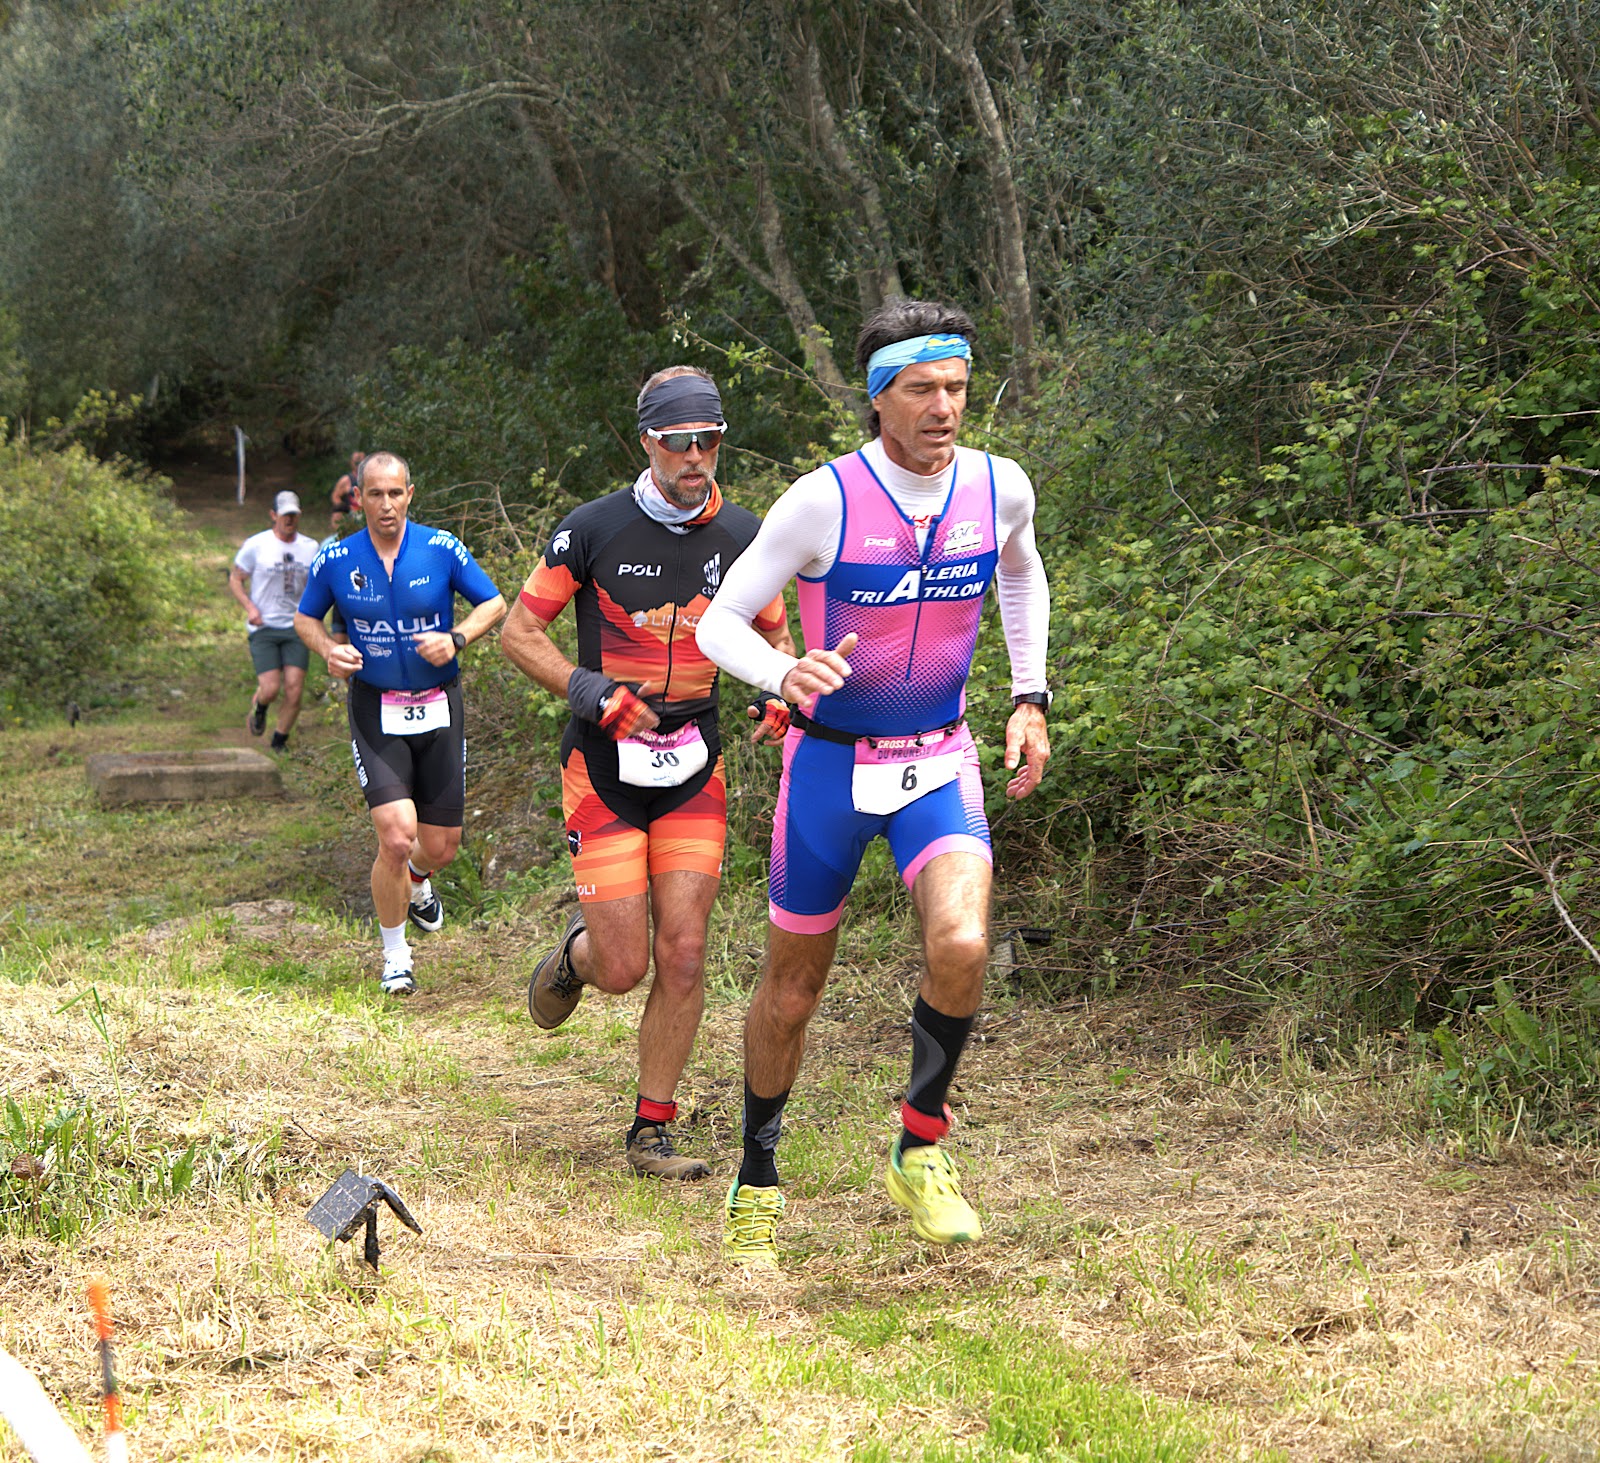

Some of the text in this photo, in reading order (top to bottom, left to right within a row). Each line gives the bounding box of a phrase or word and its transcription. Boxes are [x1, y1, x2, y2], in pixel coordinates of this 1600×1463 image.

[428, 535, 455, 550] AUTO
[618, 564, 662, 577] POLI
[409, 575, 430, 588] POLI
[353, 612, 441, 634] SAULI
[404, 705, 426, 721] 33
[877, 740, 906, 749] CROSS
[650, 749, 680, 768] 30
[877, 750, 890, 759] DU
[901, 765, 917, 791] 6
